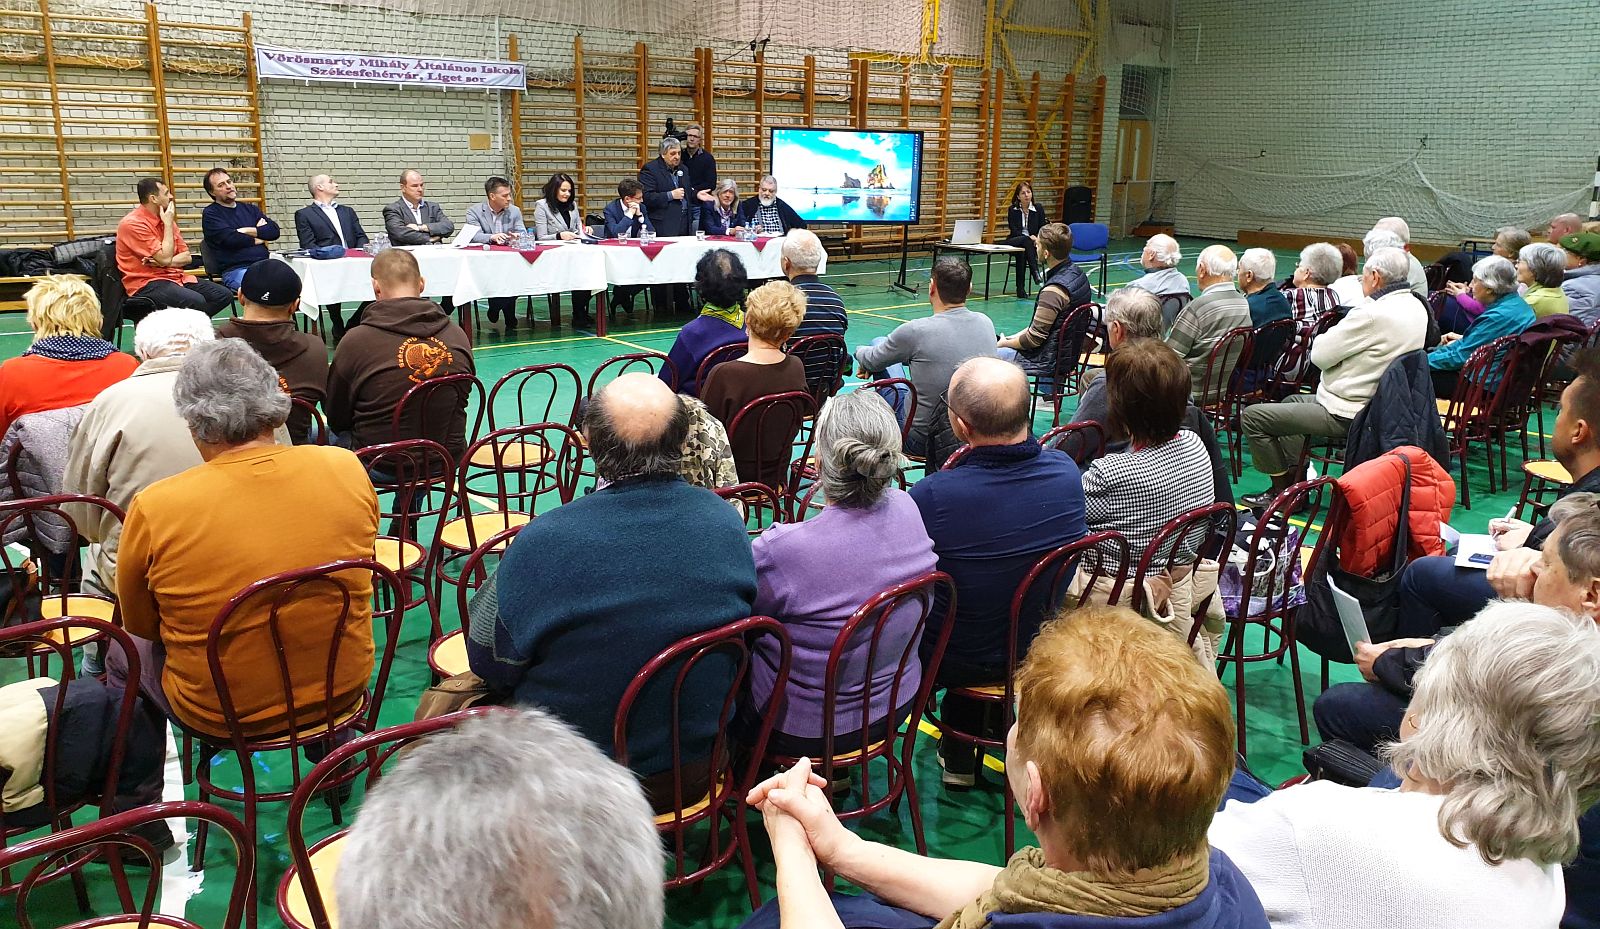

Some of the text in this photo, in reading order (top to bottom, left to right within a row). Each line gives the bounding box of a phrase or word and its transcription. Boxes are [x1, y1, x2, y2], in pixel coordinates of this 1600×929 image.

[262, 51, 521, 75] Vörösmarty Mihály Általános Iskola
[310, 66, 424, 81] Székesfehérvár,
[427, 72, 463, 83] Liget
